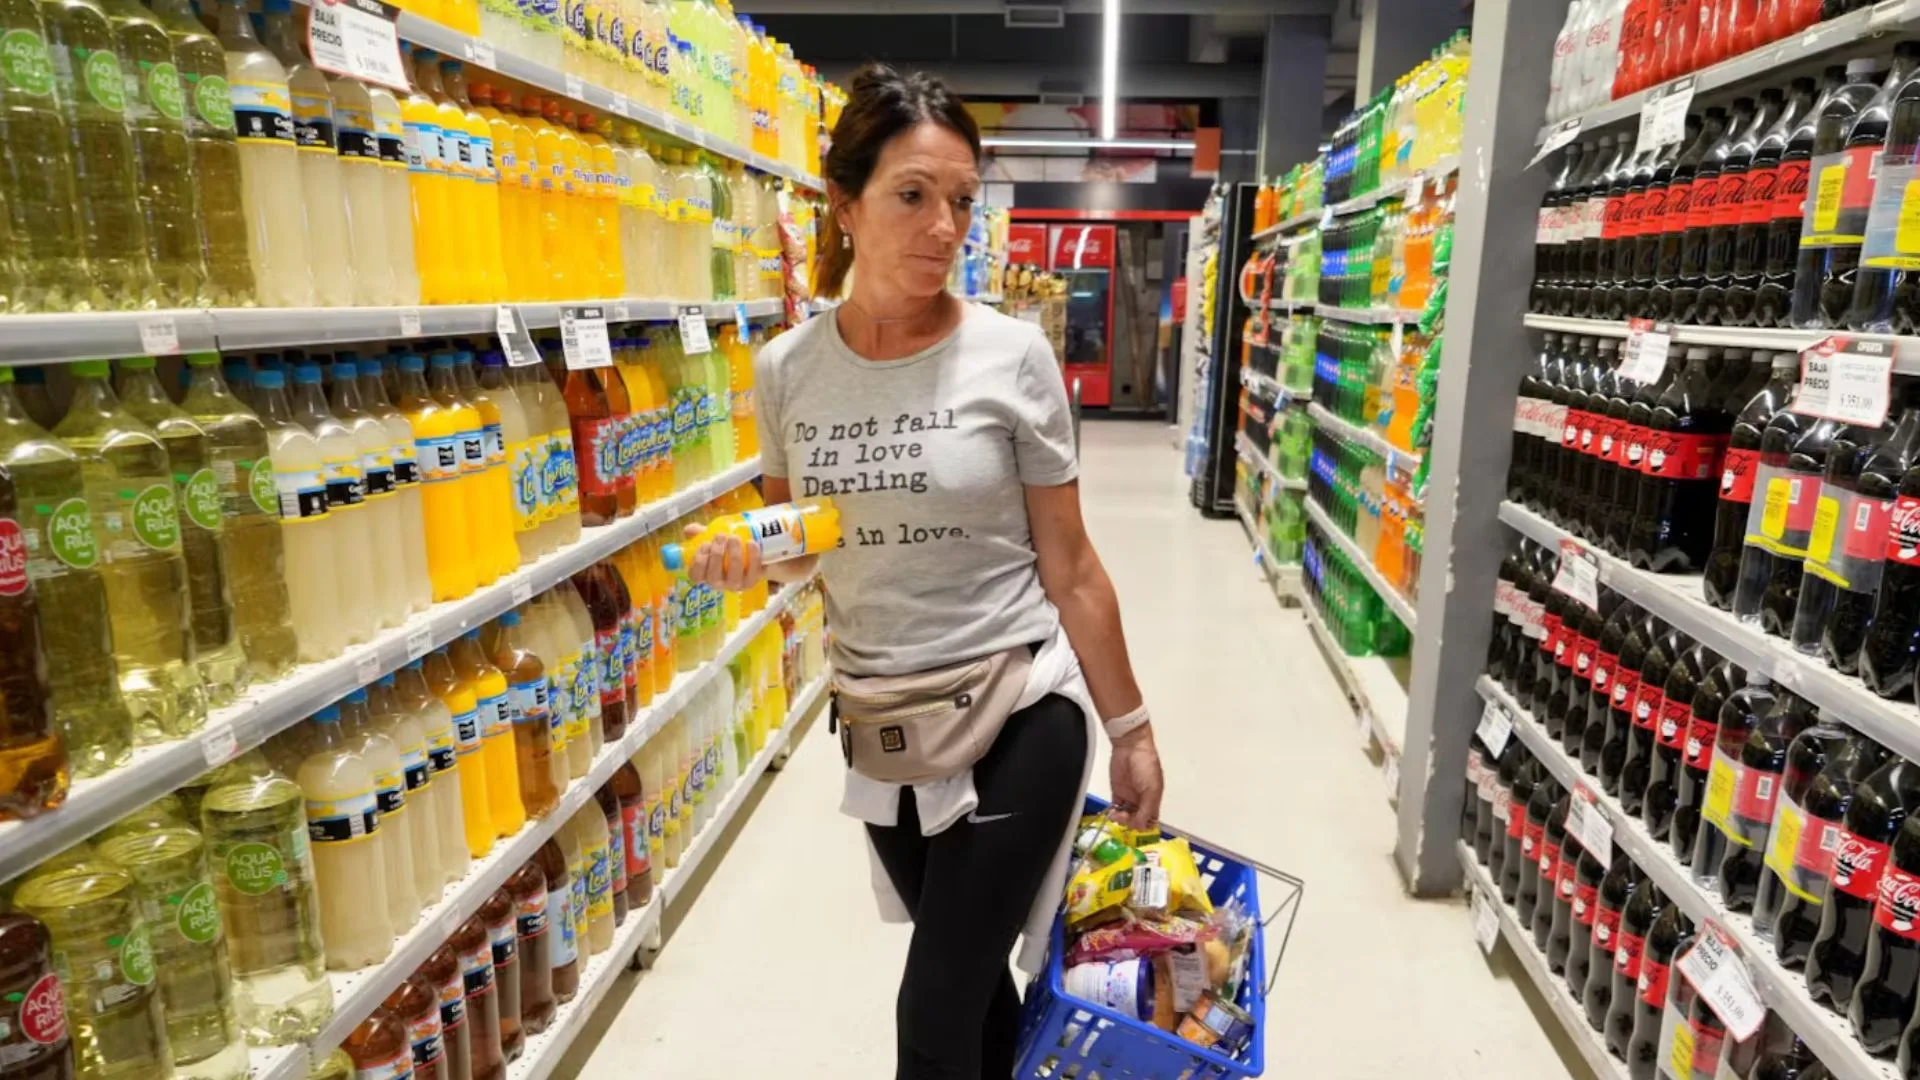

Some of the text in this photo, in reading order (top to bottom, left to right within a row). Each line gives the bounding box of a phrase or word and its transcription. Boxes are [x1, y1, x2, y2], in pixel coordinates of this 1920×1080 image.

[315, 8, 336, 26] BAJA
[311, 26, 343, 48] PRECIO
[1808, 361, 1828, 373] BAJA
[1805, 377, 1830, 390] PRECIO
[794, 408, 958, 443] Do not fall
[807, 442, 923, 468] in love
[802, 469, 928, 498] Darling
[856, 523, 970, 546] in love.
[231, 851, 276, 867] AQUA
[1838, 840, 1881, 870] Cola
[236, 866, 273, 880] RIUS
[1695, 943, 1719, 970] PRECIO
[1706, 935, 1724, 957] BAJA
